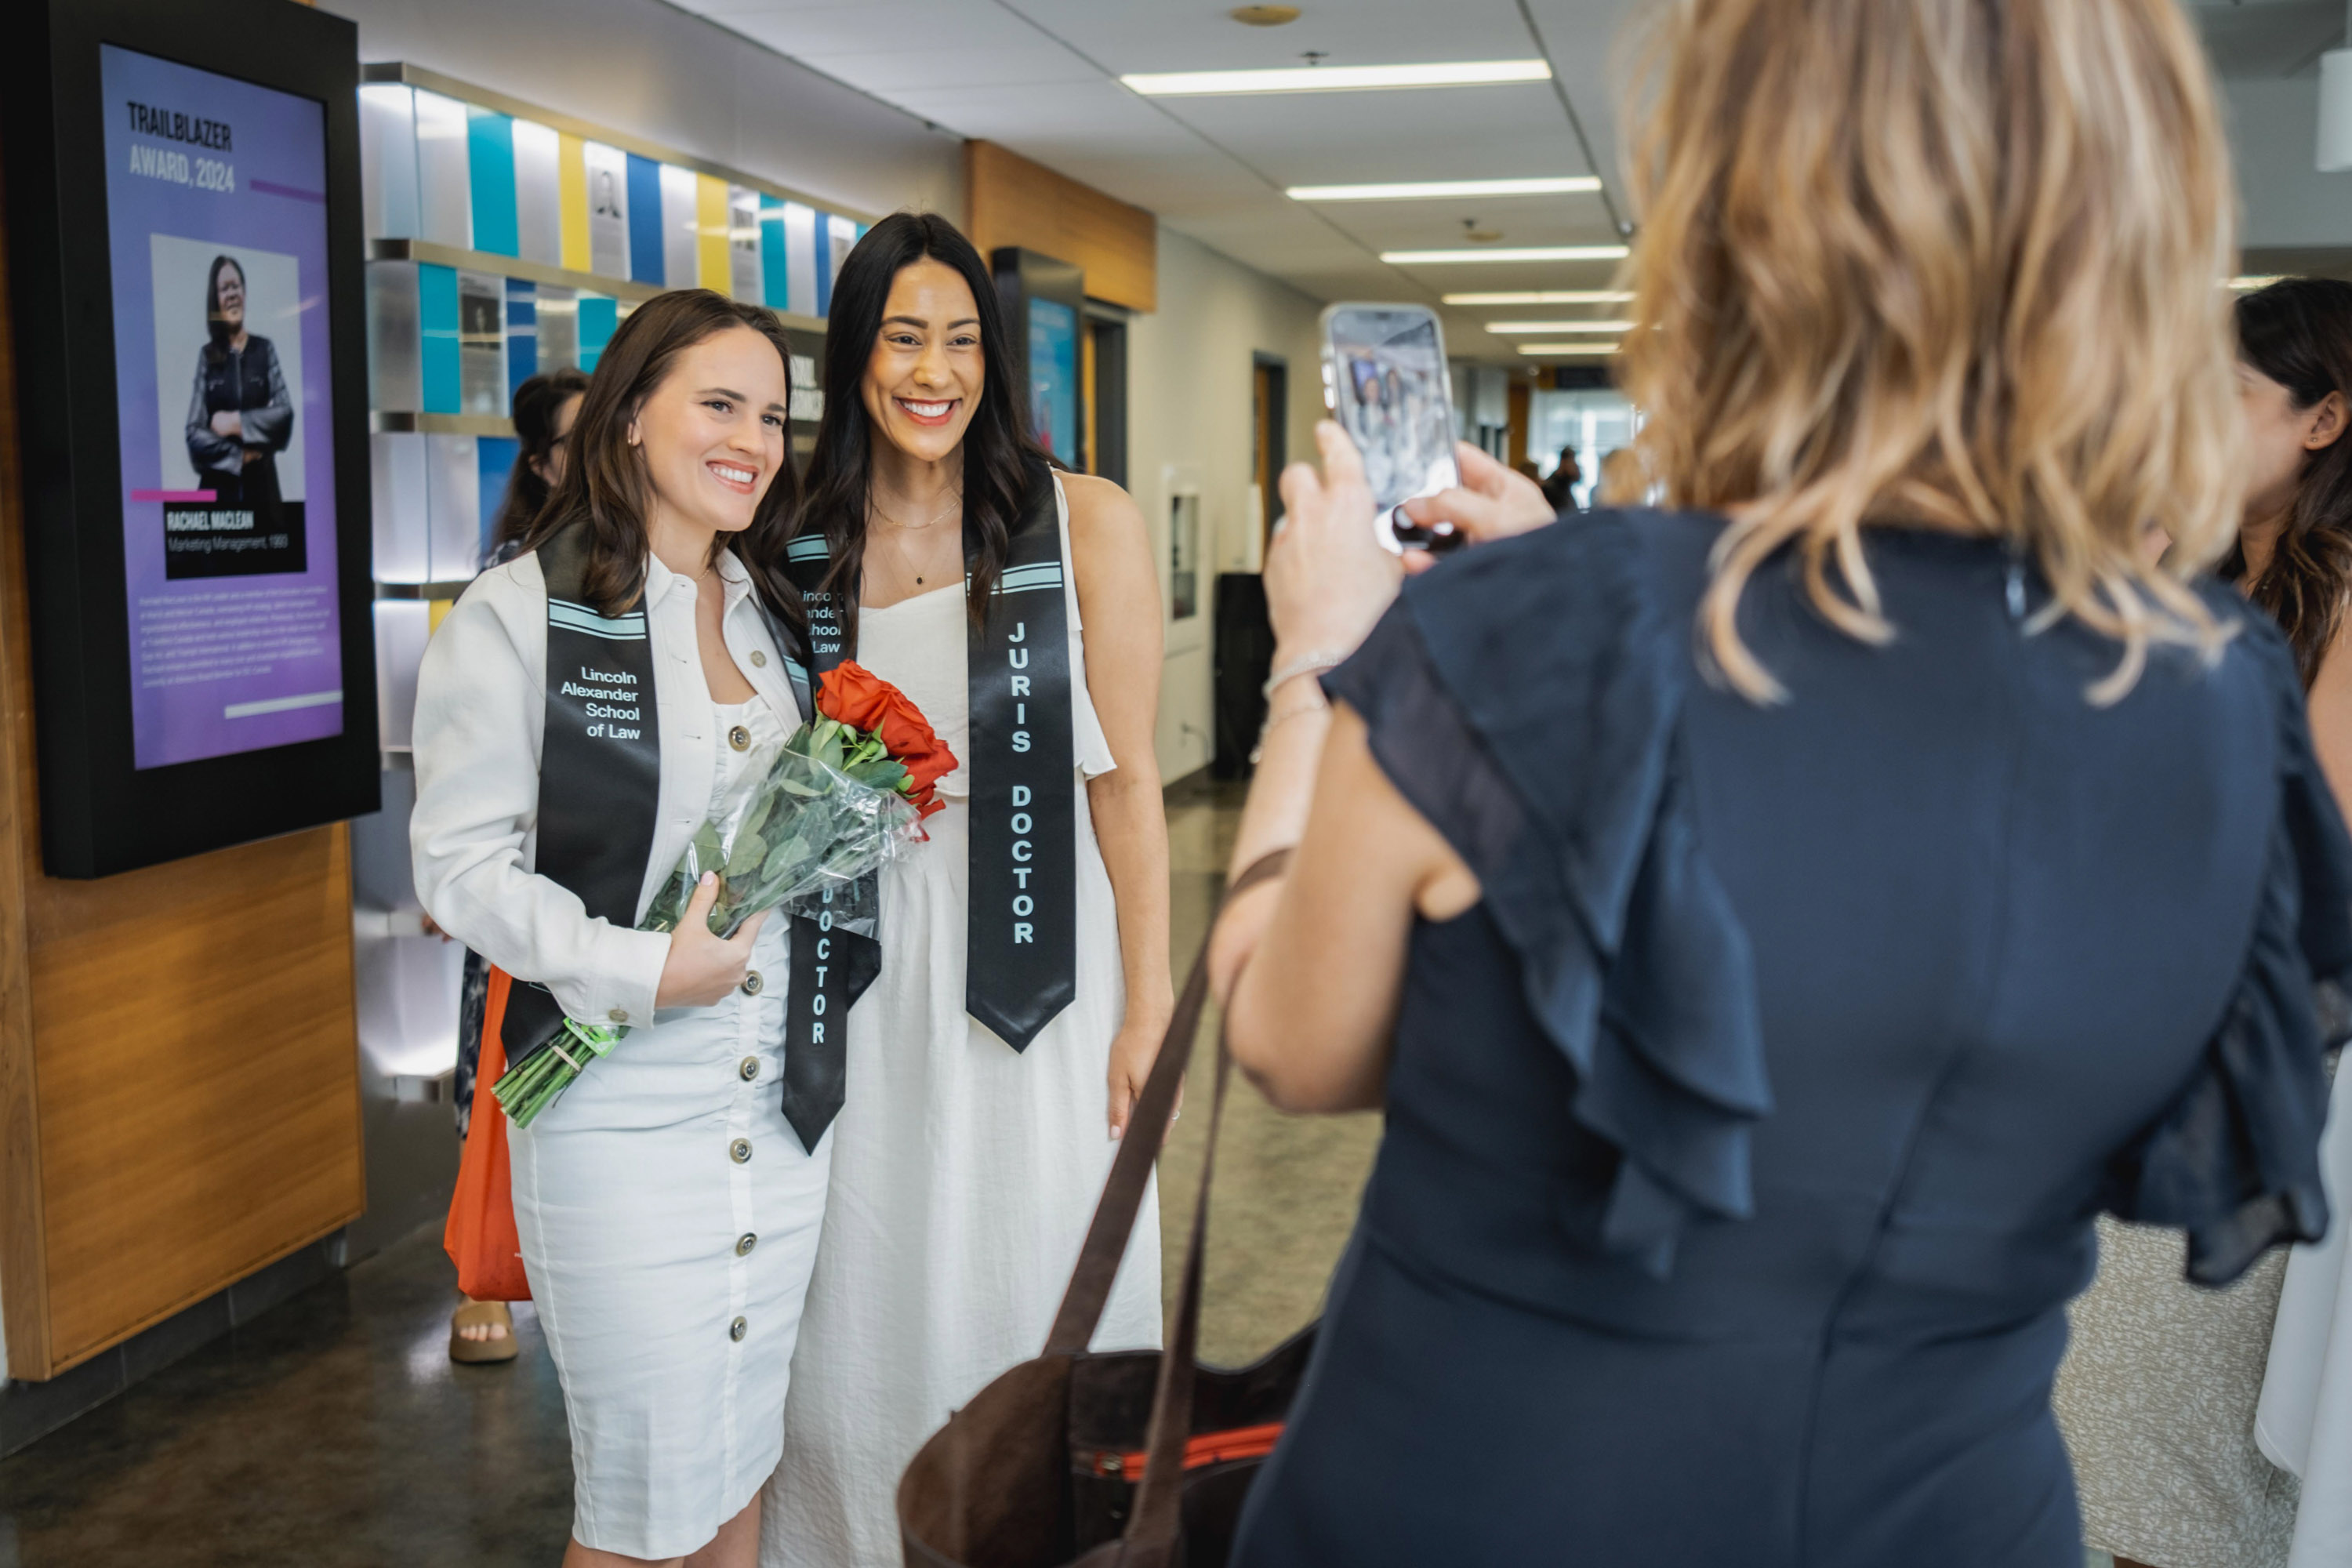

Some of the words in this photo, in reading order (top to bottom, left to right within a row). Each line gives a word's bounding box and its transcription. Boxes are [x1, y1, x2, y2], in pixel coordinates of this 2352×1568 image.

[127, 100, 233, 152] TRAILBLAZER
[129, 144, 194, 189] AWARD,
[195, 158, 234, 193] 2024
[812, 641, 840, 653] Law
[581, 666, 637, 684] Lincoln
[561, 681, 639, 702] Alexander
[1008, 622, 1031, 753] JURIS
[586, 702, 640, 720] School
[586, 724, 604, 737] of
[609, 724, 641, 739] Law
[1011, 786, 1034, 944] DOCTOR
